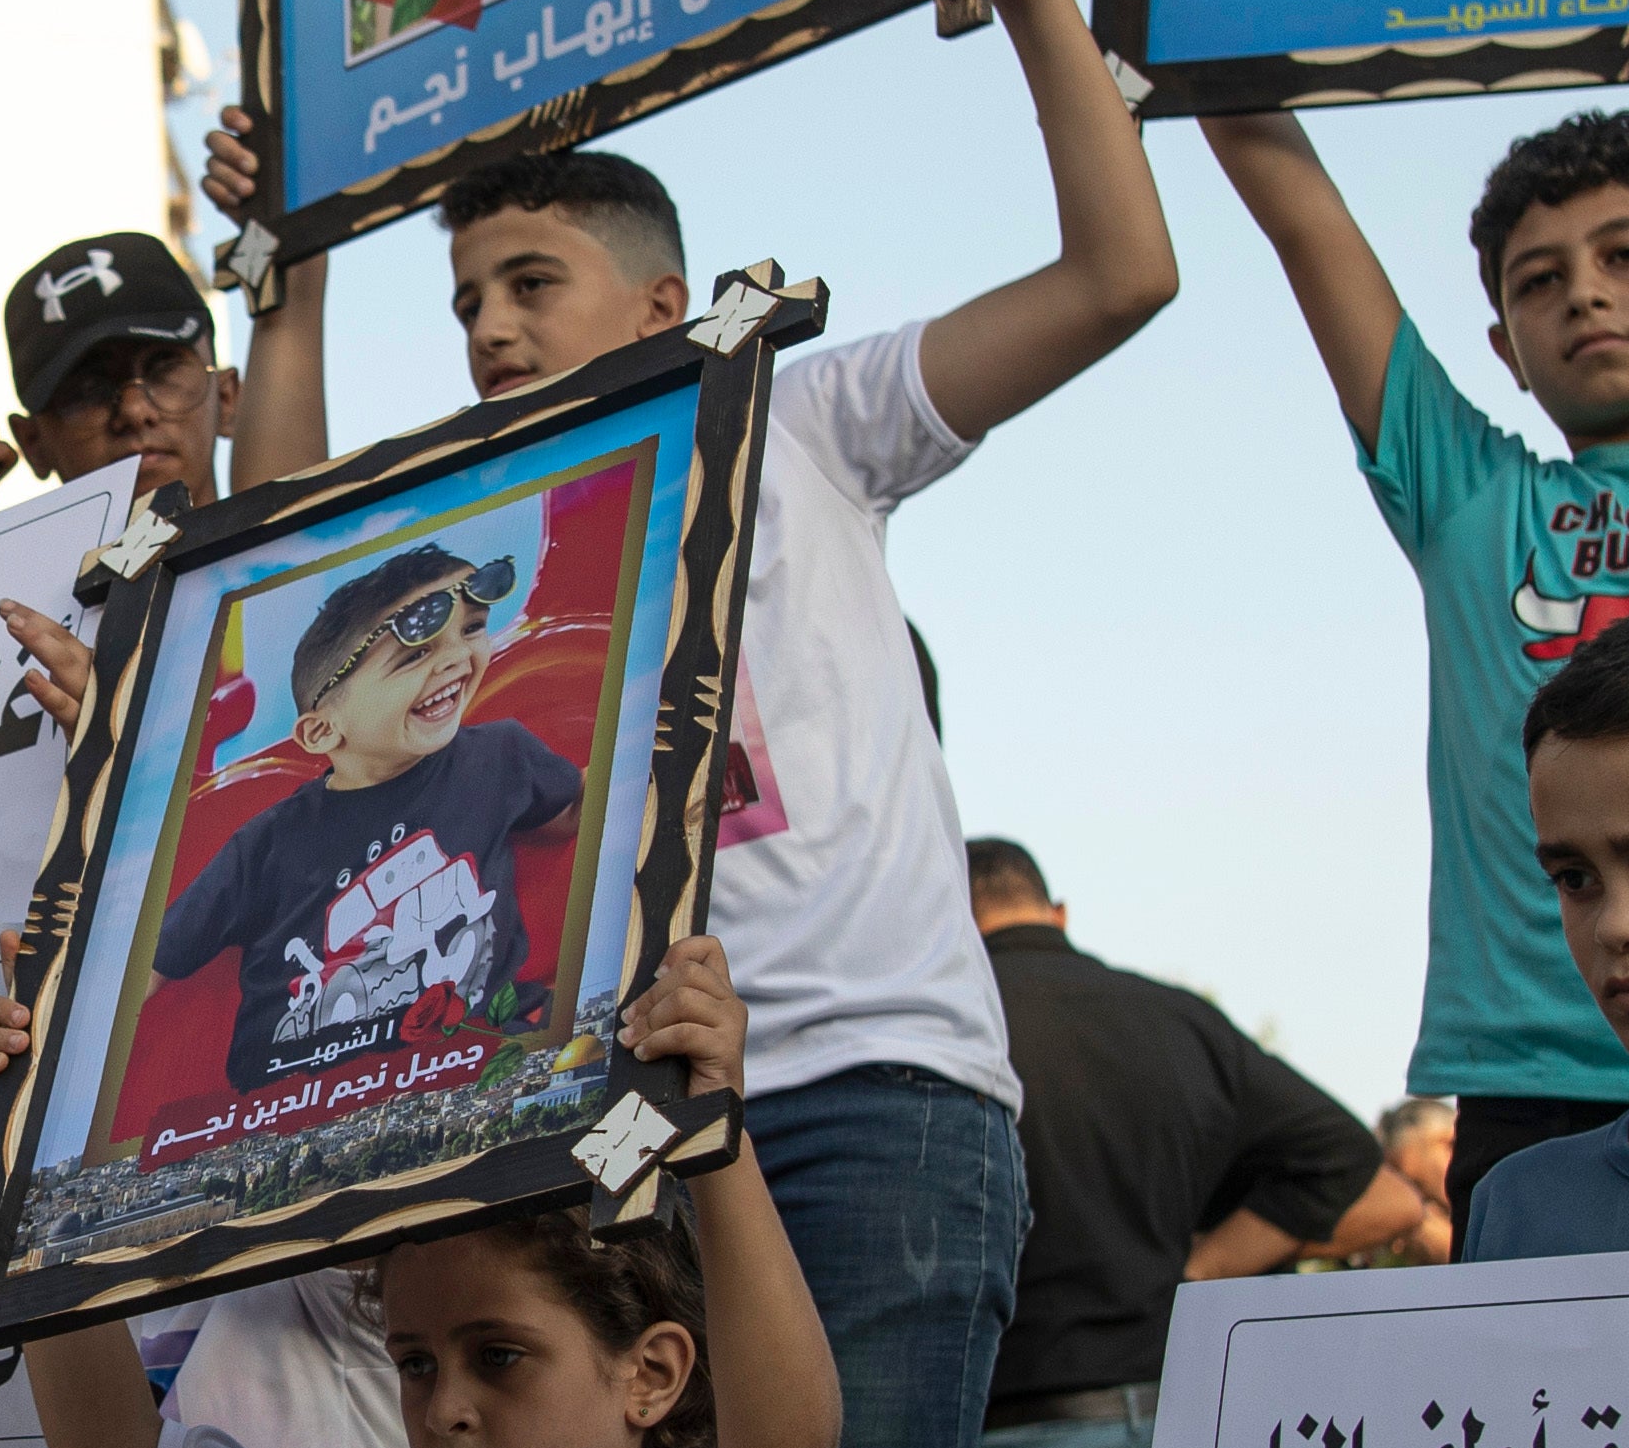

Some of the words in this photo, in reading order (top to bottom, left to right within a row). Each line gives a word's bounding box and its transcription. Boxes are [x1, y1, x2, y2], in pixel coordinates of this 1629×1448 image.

[363, 47, 469, 152] نجم
[267, 1020, 395, 1073] الشهيد
[395, 1044, 484, 1089] جميل
[243, 1081, 322, 1130] الدين
[327, 1063, 388, 1107] نجم
[151, 1104, 236, 1155] نجم
